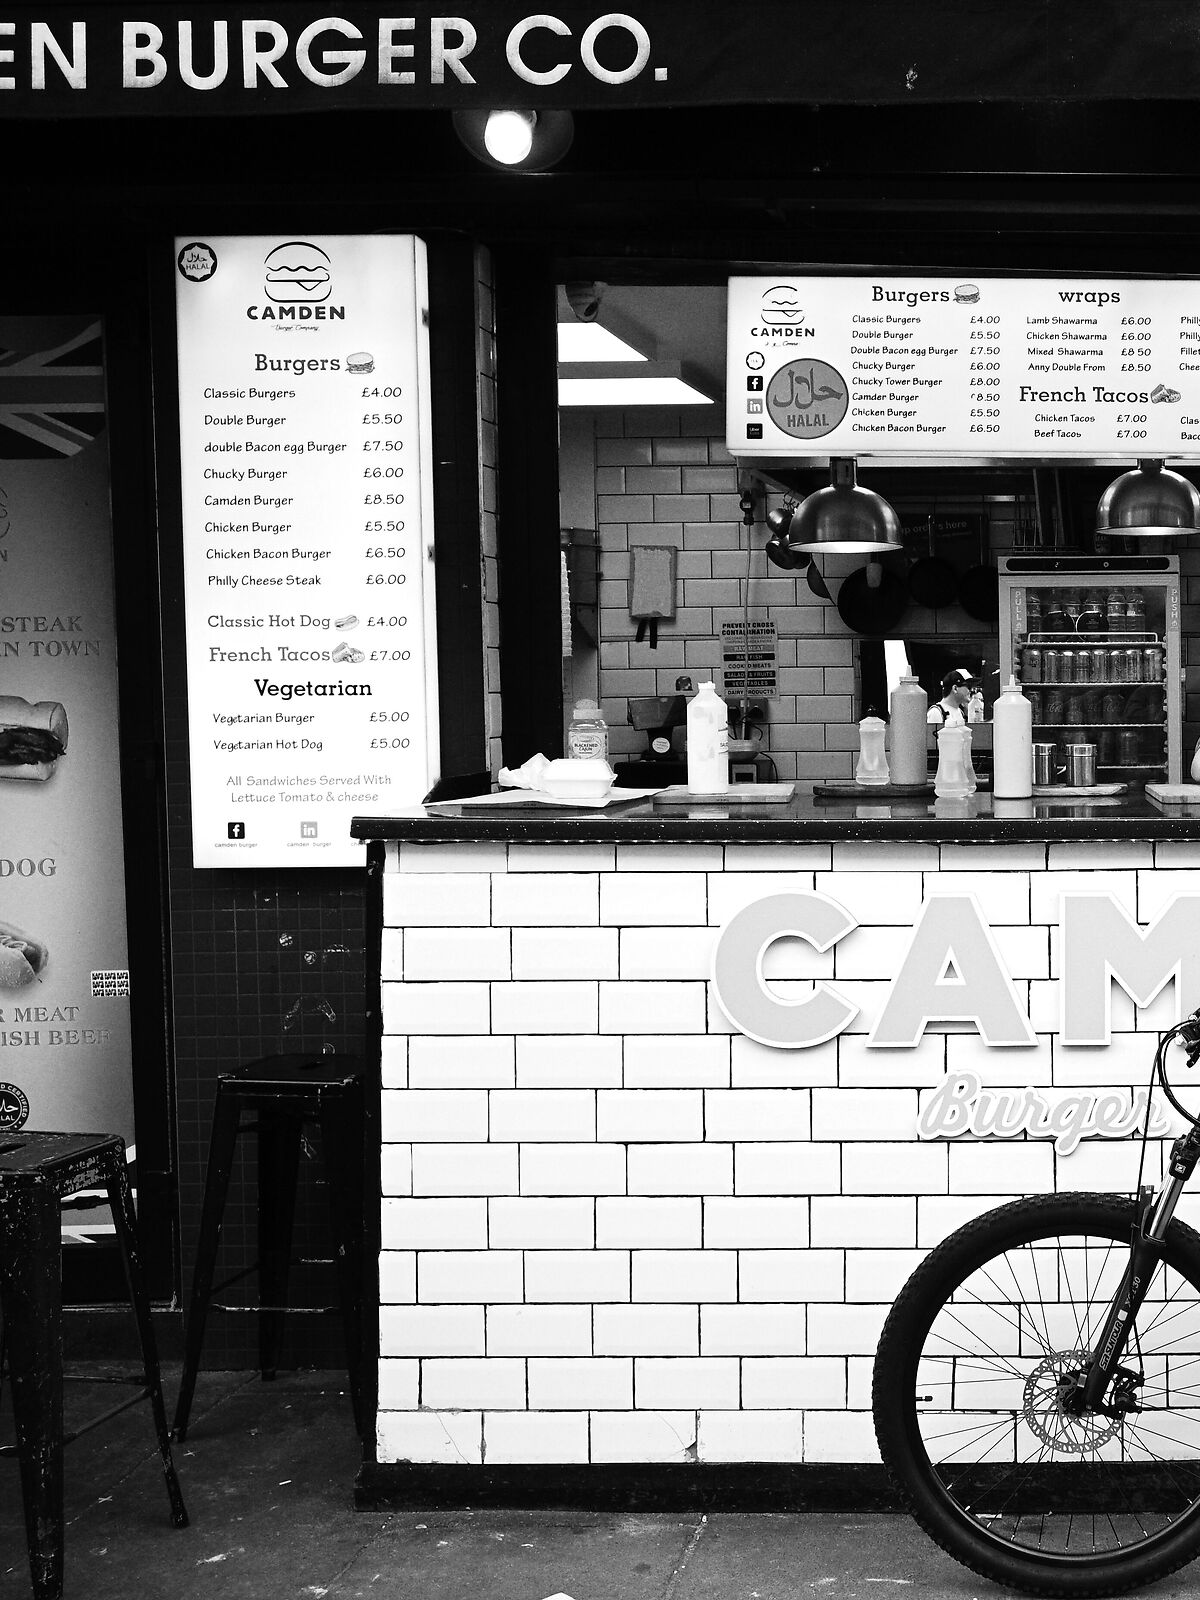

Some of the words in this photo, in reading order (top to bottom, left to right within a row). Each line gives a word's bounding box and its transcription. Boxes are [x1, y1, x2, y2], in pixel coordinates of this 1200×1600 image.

[122, 17, 479, 91] BURGER
[505, 14, 669, 87] CO.
[872, 286, 949, 307] Burgers
[1059, 292, 1120, 307] wraps
[247, 306, 345, 320] CAMDEN
[853, 315, 883, 323] Classic
[886, 315, 921, 325] Burgers
[751, 328, 814, 337] CAMDEN
[1027, 332, 1059, 340] Chicken
[1062, 332, 1107, 340] Shawarma
[851, 346, 879, 354] Double
[883, 346, 908, 354] Bacon
[929, 347, 958, 356] Burger
[255, 354, 340, 375] Burgers
[1028, 363, 1050, 372] Anny
[1053, 363, 1081, 371] Double
[852, 377, 883, 387] Chucky
[886, 377, 910, 385] Tower
[913, 378, 942, 387] Burger
[970, 378, 1000, 386] £8.00
[204, 388, 245, 398] Classic
[249, 388, 295, 401] Burgers
[362, 387, 401, 397] £4.00
[890, 393, 919, 403] Burger
[1020, 386, 1086, 402] French
[1093, 387, 1148, 403] Tacos
[787, 414, 829, 427] HALAL
[888, 424, 914, 432] Bacon
[917, 424, 946, 434] Burger
[970, 424, 1000, 432] £6.50
[1117, 430, 1147, 438] £7.00
[205, 442, 242, 452] double
[246, 442, 280, 451] Bacon
[284, 445, 303, 454] egg
[308, 441, 346, 454] Burger
[363, 441, 403, 451] £7.50
[205, 495, 250, 505] Camden
[254, 495, 293, 508] Burger
[364, 494, 404, 504] £8.50
[207, 549, 249, 559] Chicken
[254, 549, 288, 558] Bacon
[292, 548, 331, 561] Burger
[366, 548, 405, 558] £6.50
[1, 615, 83, 633] STEAK
[208, 615, 263, 627] Classic
[269, 615, 294, 627] Hot
[300, 615, 330, 629] Dog
[367, 616, 407, 626] £4.00
[29, 640, 101, 657] TOWN
[254, 679, 372, 700] Vegetarian
[213, 714, 272, 726] Vegetarian
[276, 713, 314, 725] Burger
[370, 712, 409, 722] £5.00
[227, 776, 241, 785] All
[247, 776, 316, 785] Sandwiches
[320, 776, 360, 785] Served
[364, 775, 391, 784] With
[232, 793, 275, 802] Lettuce
[279, 792, 323, 802] Tomato
[326, 792, 334, 801] &
[338, 792, 378, 801] cheese
[0, 858, 57, 877] DOG
[14, 1006, 80, 1022] MEAT
[48, 1029, 110, 1046] BEEF
